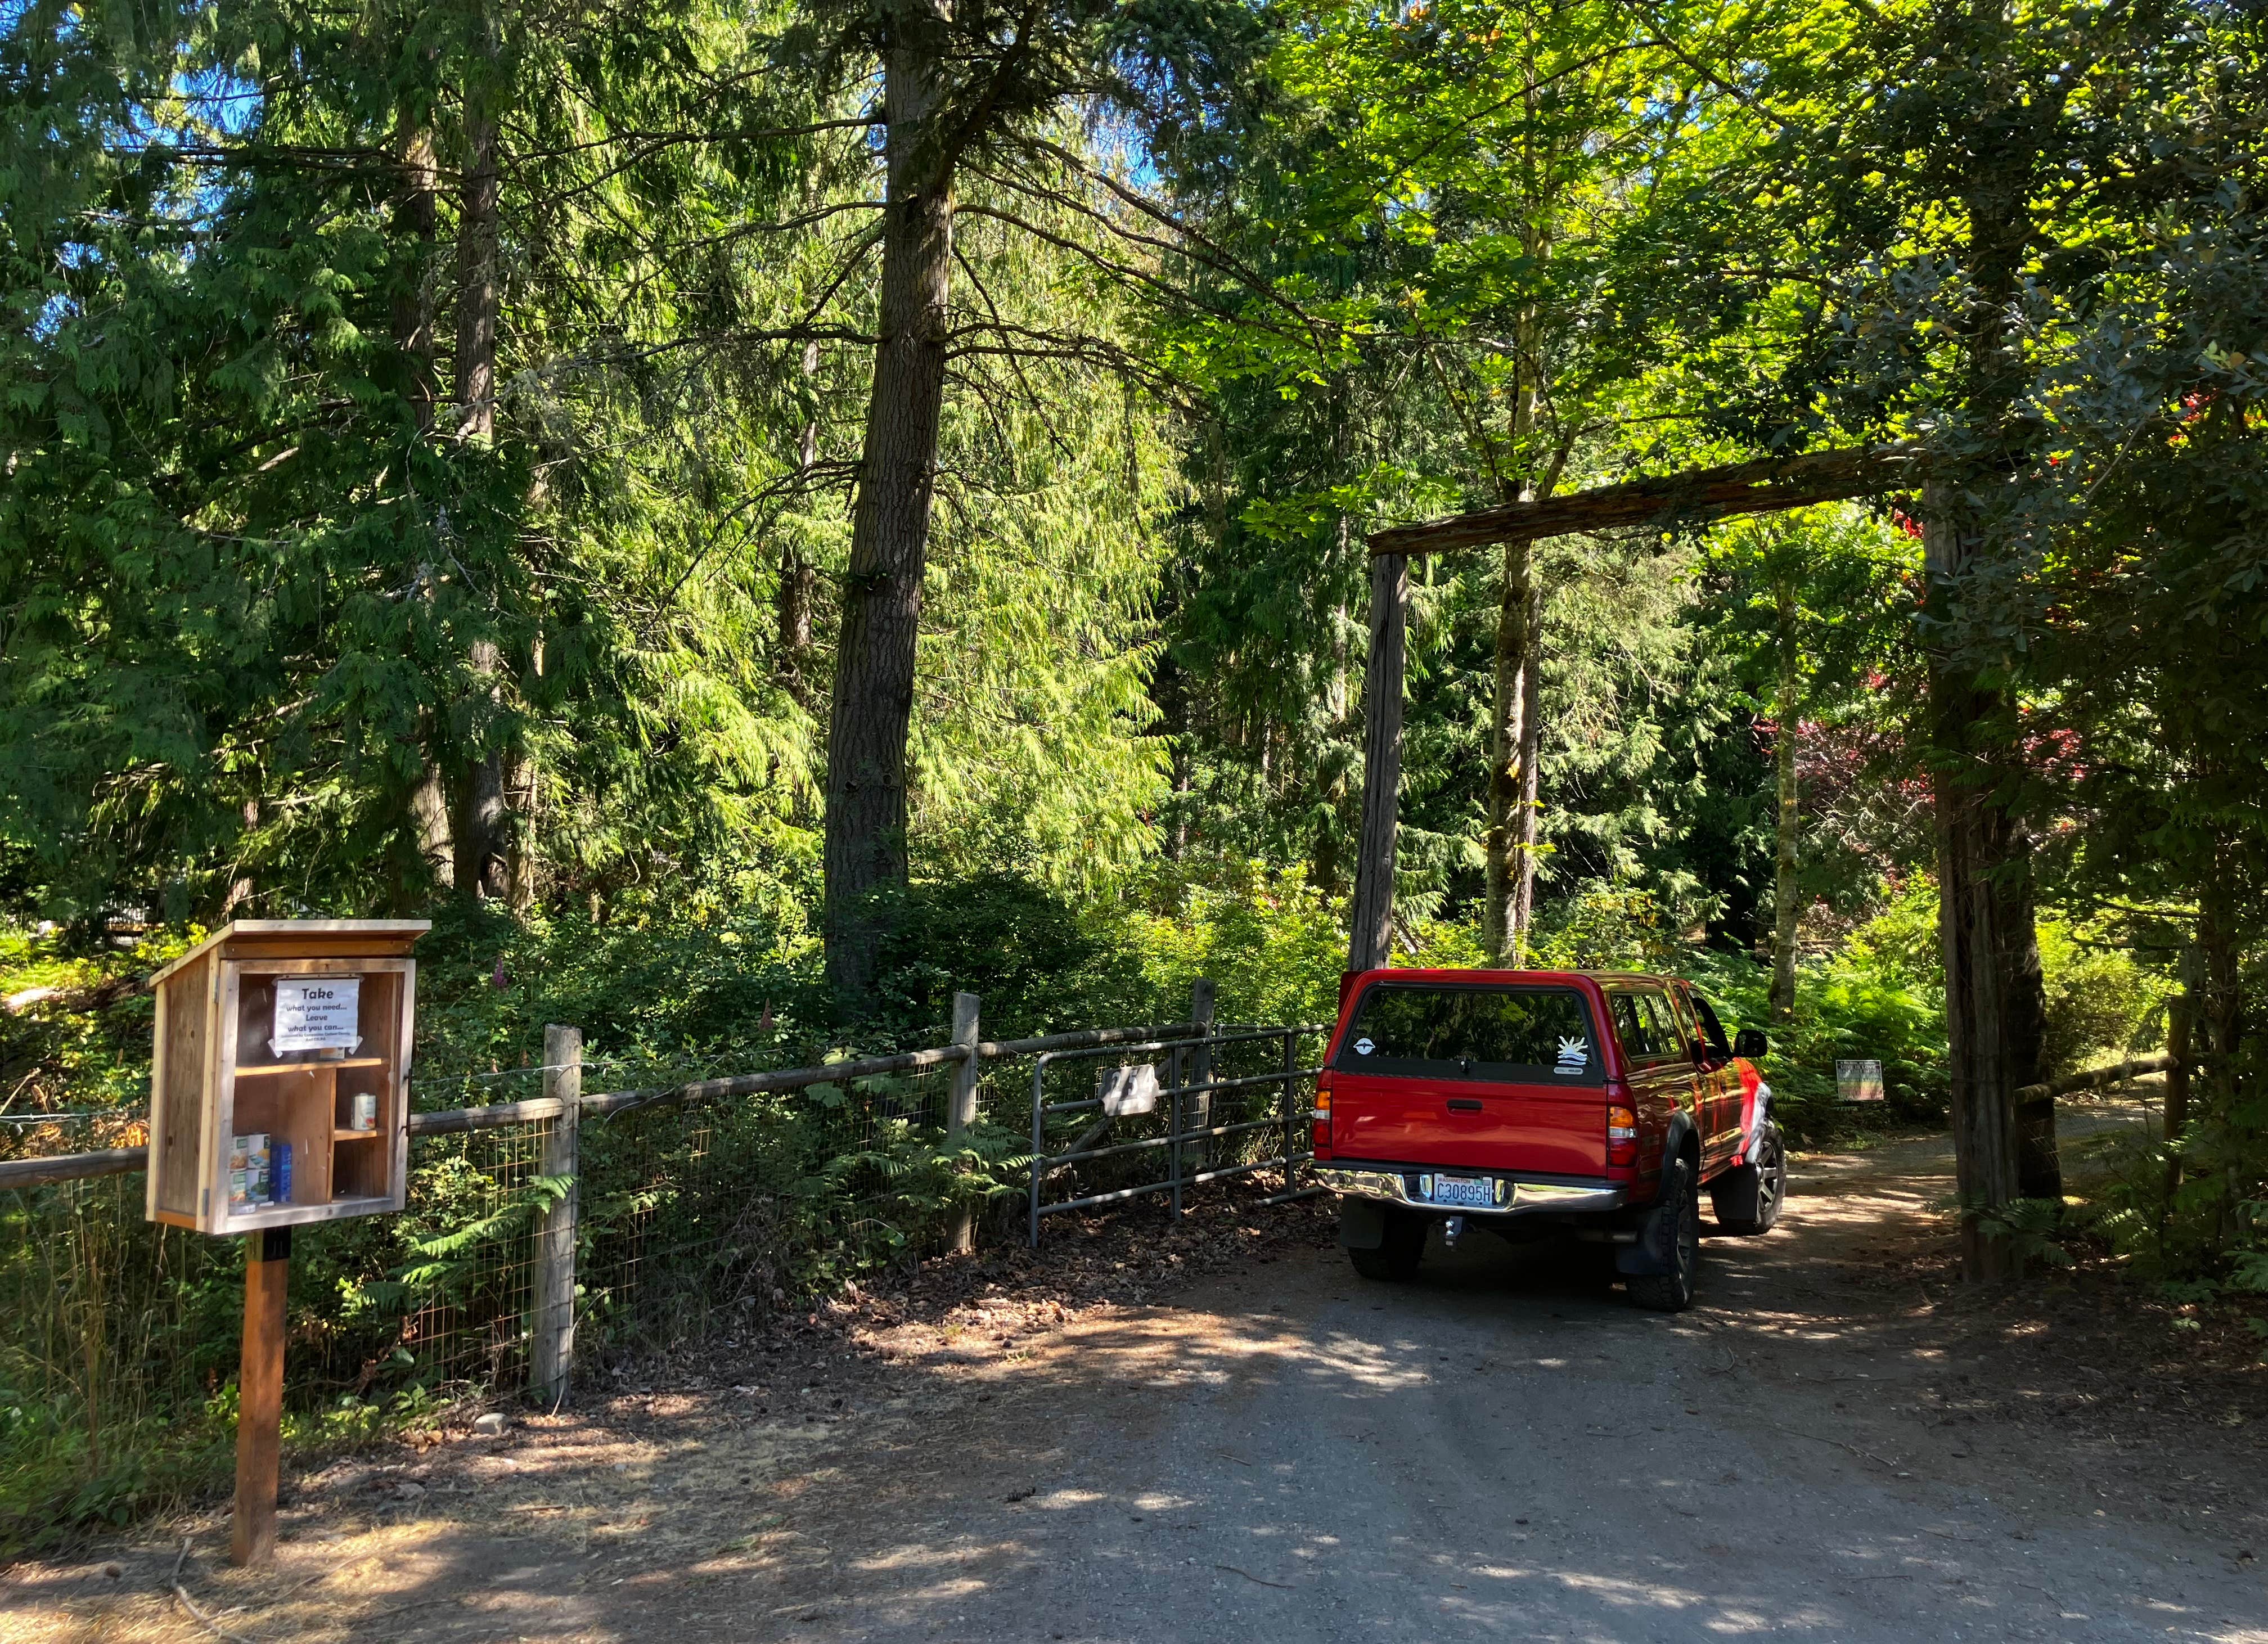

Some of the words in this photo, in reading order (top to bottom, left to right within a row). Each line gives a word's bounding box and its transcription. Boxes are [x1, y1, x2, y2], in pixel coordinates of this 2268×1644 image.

[302, 988, 334, 999] Take
[1110, 1066, 1154, 1098] 254
[1438, 1183, 1490, 1202] C30895H
